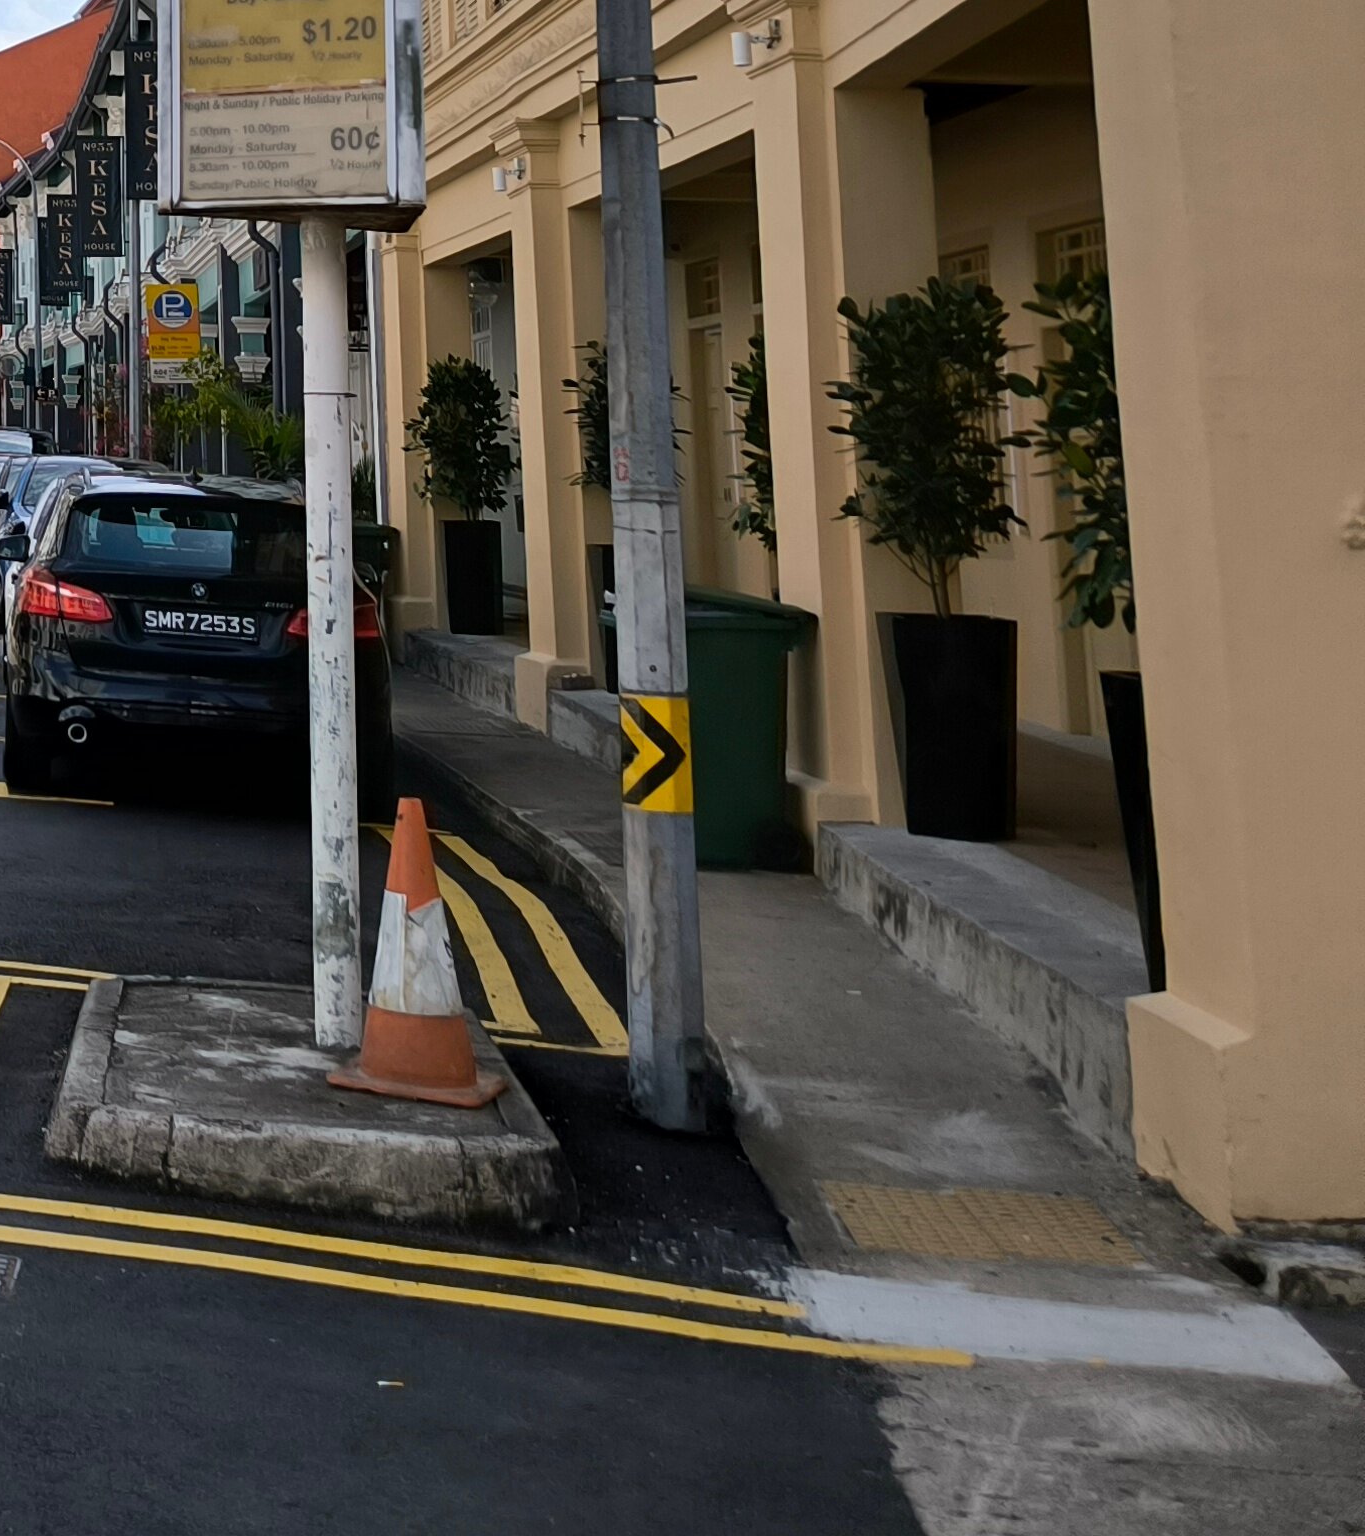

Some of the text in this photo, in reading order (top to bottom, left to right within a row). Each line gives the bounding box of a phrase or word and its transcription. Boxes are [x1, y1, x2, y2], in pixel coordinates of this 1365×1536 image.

[302, 15, 377, 44] $1.20
[189, 55, 232, 67] Monday
[244, 50, 294, 64] Saturday
[184, 100, 210, 112] Night
[212, 99, 220, 109] &
[222, 96, 259, 110] Sunday
[269, 95, 300, 107] Public
[303, 91, 342, 105] Holiday
[344, 89, 384, 105] Parking
[242, 122, 290, 136] 10.00pm
[330, 125, 380, 155] 60¢
[189, 143, 234, 156] Monday
[245, 140, 297, 154] Saturday
[241, 158, 289, 172] 10.00pm
[274, 175, 318, 190] Holiday
[84, 242, 116, 252] HOUSE
[53, 280, 79, 288] HOUSE
